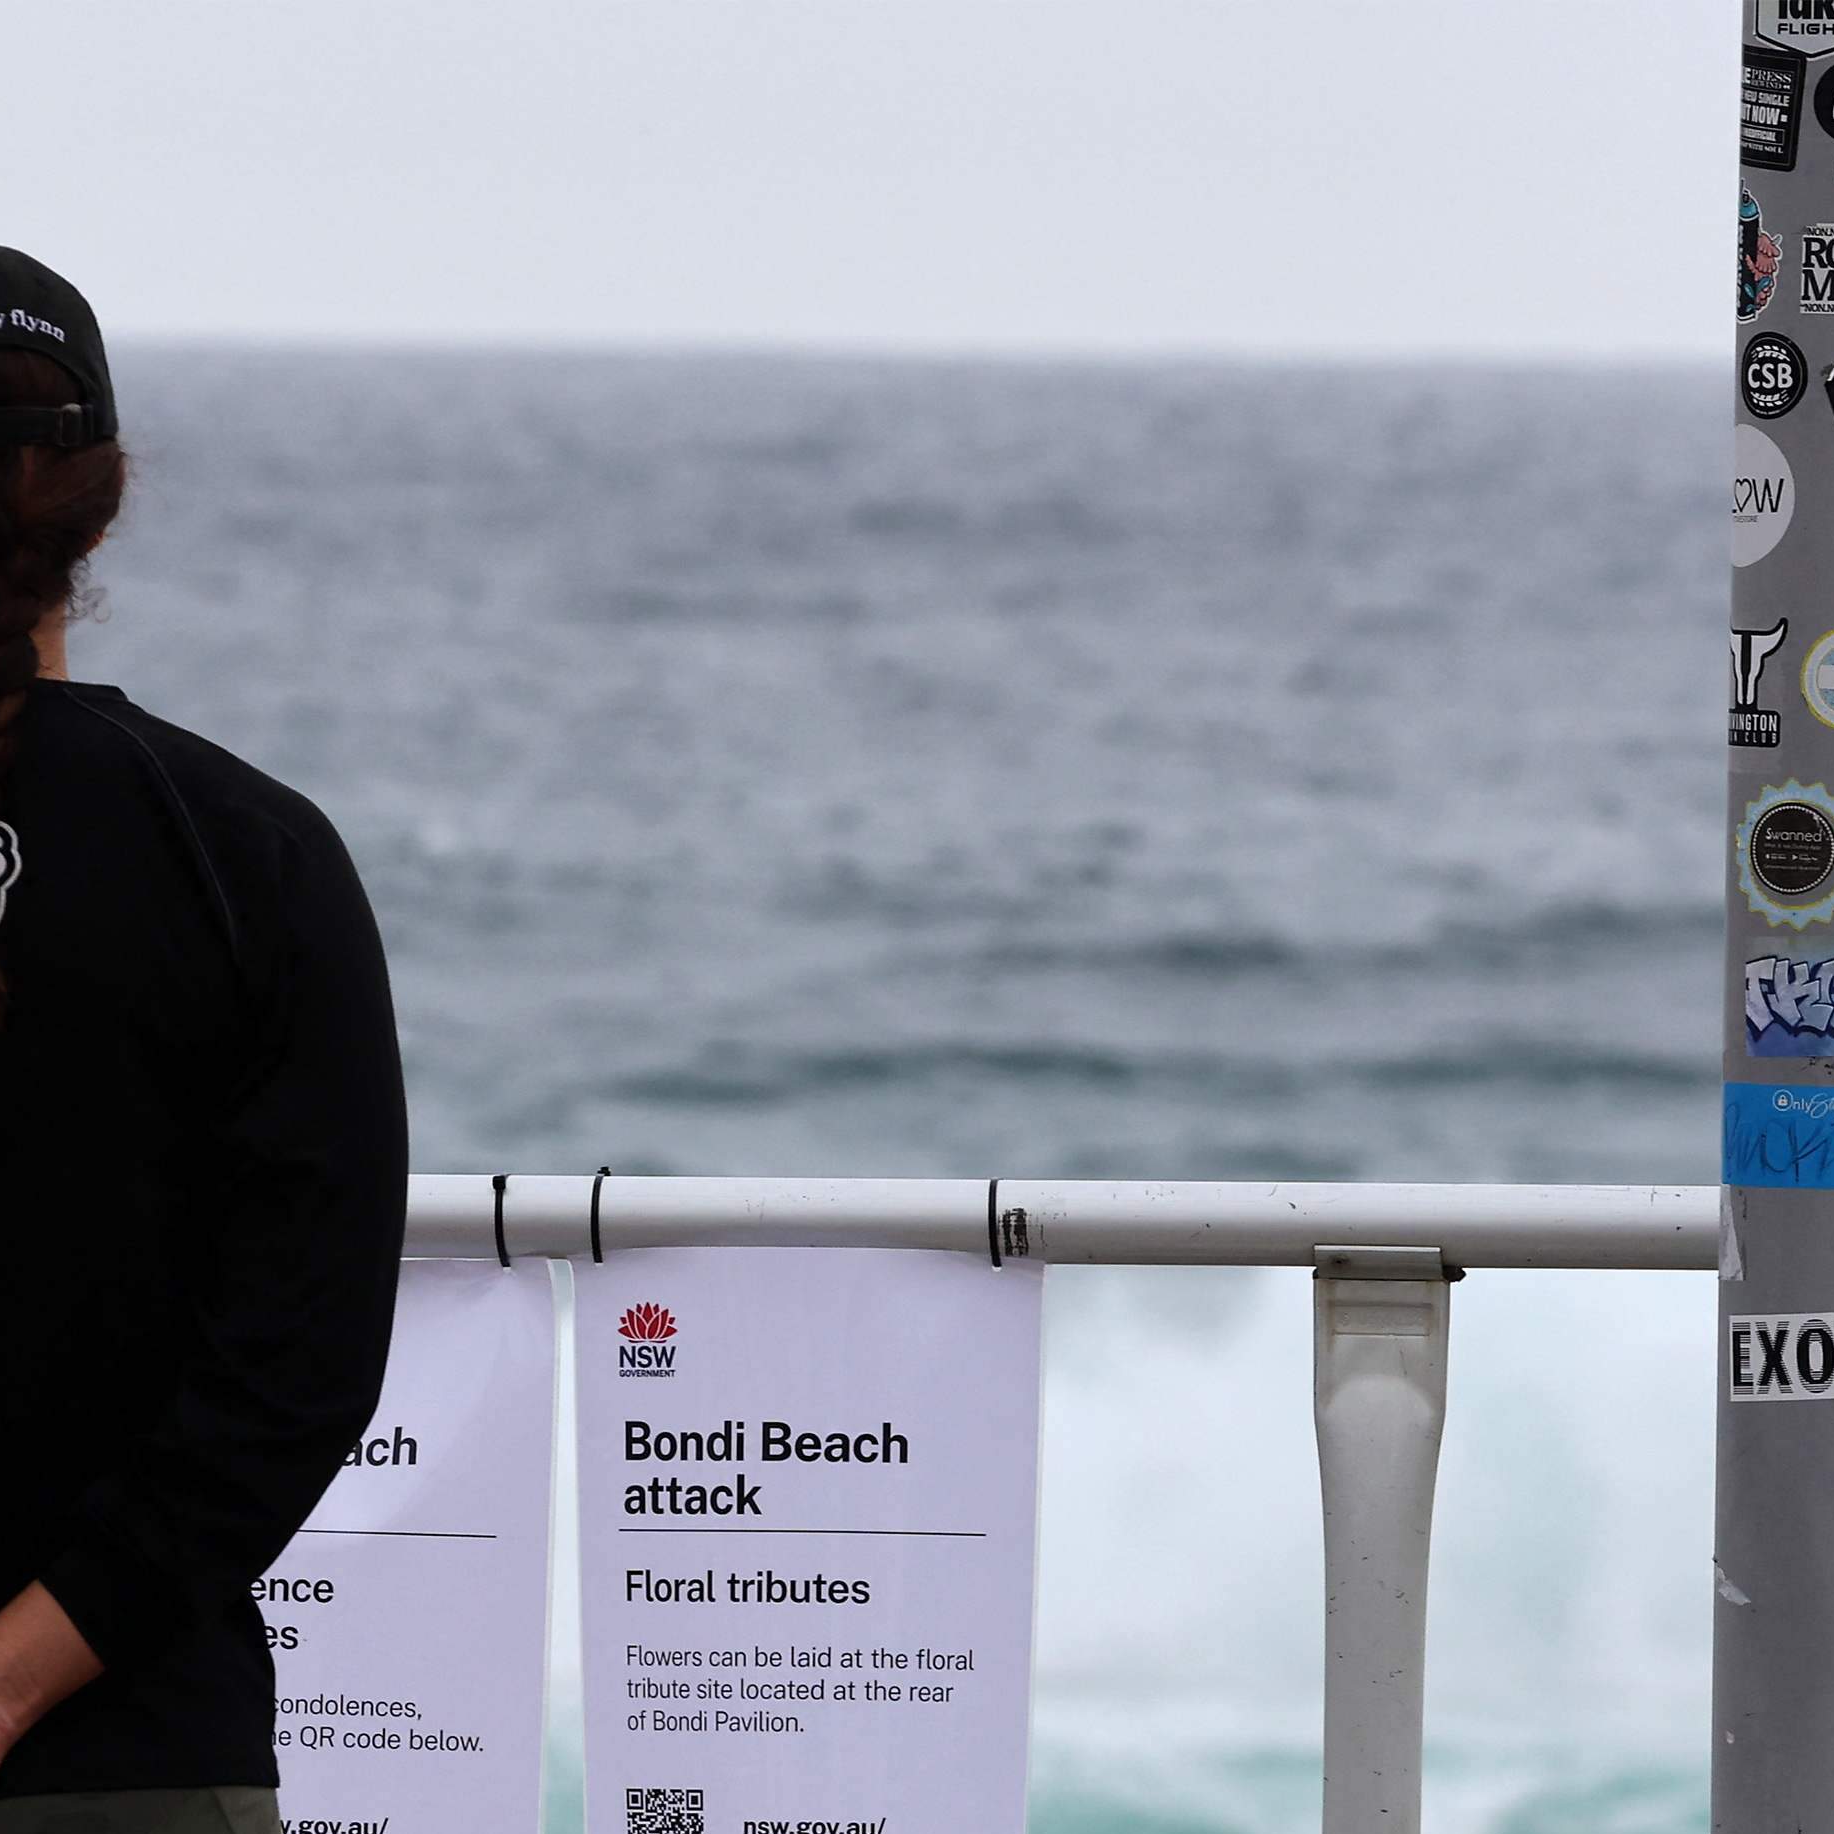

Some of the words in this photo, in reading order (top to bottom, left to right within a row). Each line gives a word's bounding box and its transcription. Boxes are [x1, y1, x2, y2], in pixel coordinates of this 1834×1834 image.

[1752, 105, 1781, 125] NOW
[10, 308, 65, 343] flynn
[1748, 363, 1793, 389] CSB
[1765, 827, 1823, 842] Swanned
[619, 1345, 676, 1368] NSW
[619, 1369, 676, 1378] GOVERNMENT
[341, 1427, 418, 1467] ach
[624, 1420, 745, 1462] Bondi
[761, 1421, 909, 1464] Beach
[623, 1473, 763, 1516] attack
[626, 1569, 717, 1603] Floral
[726, 1569, 870, 1605] tributes
[626, 1644, 703, 1667] Flowers
[708, 1651, 747, 1668] can
[754, 1645, 783, 1668] be
[790, 1645, 832, 1668] laid
[840, 1648, 863, 1669] at
[870, 1647, 909, 1670] the
[915, 1648, 975, 1671] floral
[626, 1676, 691, 1700] tribute
[696, 1678, 733, 1700] site
[740, 1677, 825, 1701] located
[833, 1681, 856, 1701] at
[863, 1679, 902, 1702] the
[909, 1686, 954, 1703] rear
[627, 1709, 647, 1731] of
[653, 1709, 708, 1732] Bondi
[715, 1710, 804, 1733] Pavilion.
[299, 1725, 336, 1750] QR
[342, 1728, 402, 1750] code
[409, 1729, 485, 1752] below.
